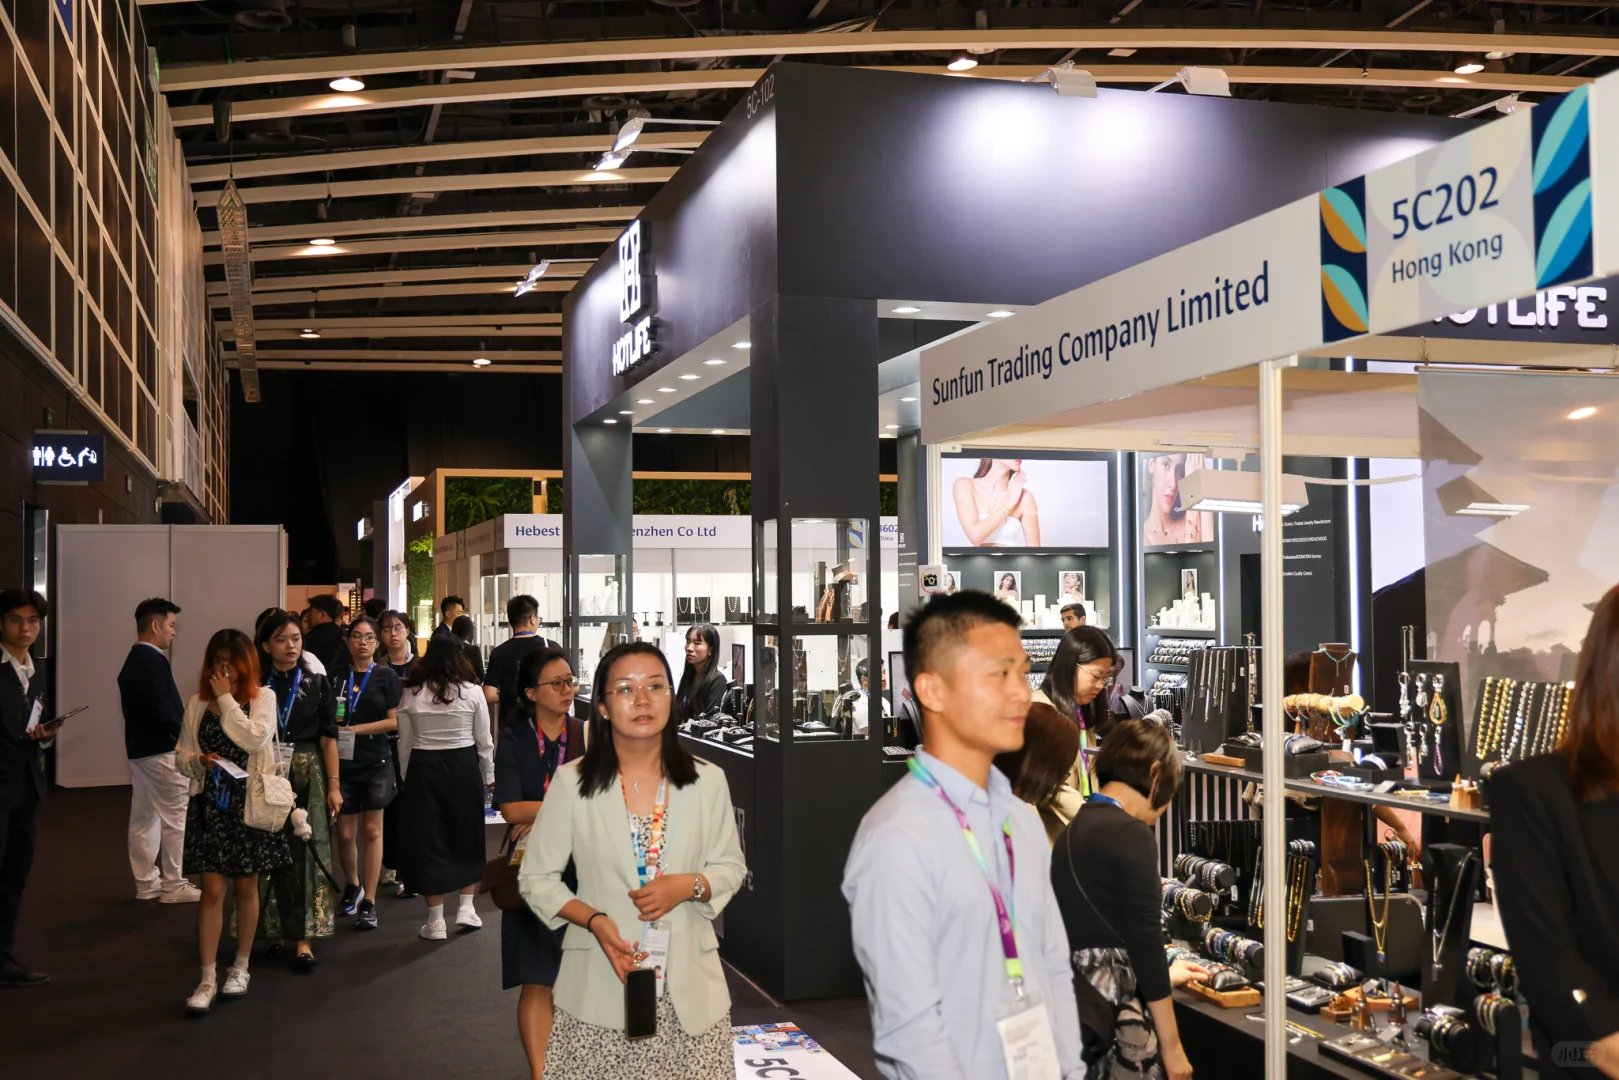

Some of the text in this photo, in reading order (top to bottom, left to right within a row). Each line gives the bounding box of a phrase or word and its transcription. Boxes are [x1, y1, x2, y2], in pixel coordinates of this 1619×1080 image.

[747, 73, 775, 119] 5C-102
[1392, 166, 1500, 240] 5C202
[1392, 233, 1504, 284] Hong Kong
[1433, 286, 1608, 329] LIFE
[612, 316, 650, 377] HOTLIFE
[932, 260, 1270, 406] Sunfun Trading Company Limited
[515, 525, 561, 537] Hebest
[677, 526, 694, 537] Co
[697, 526, 717, 537] Ltd
[744, 1058, 808, 1080] 5C
